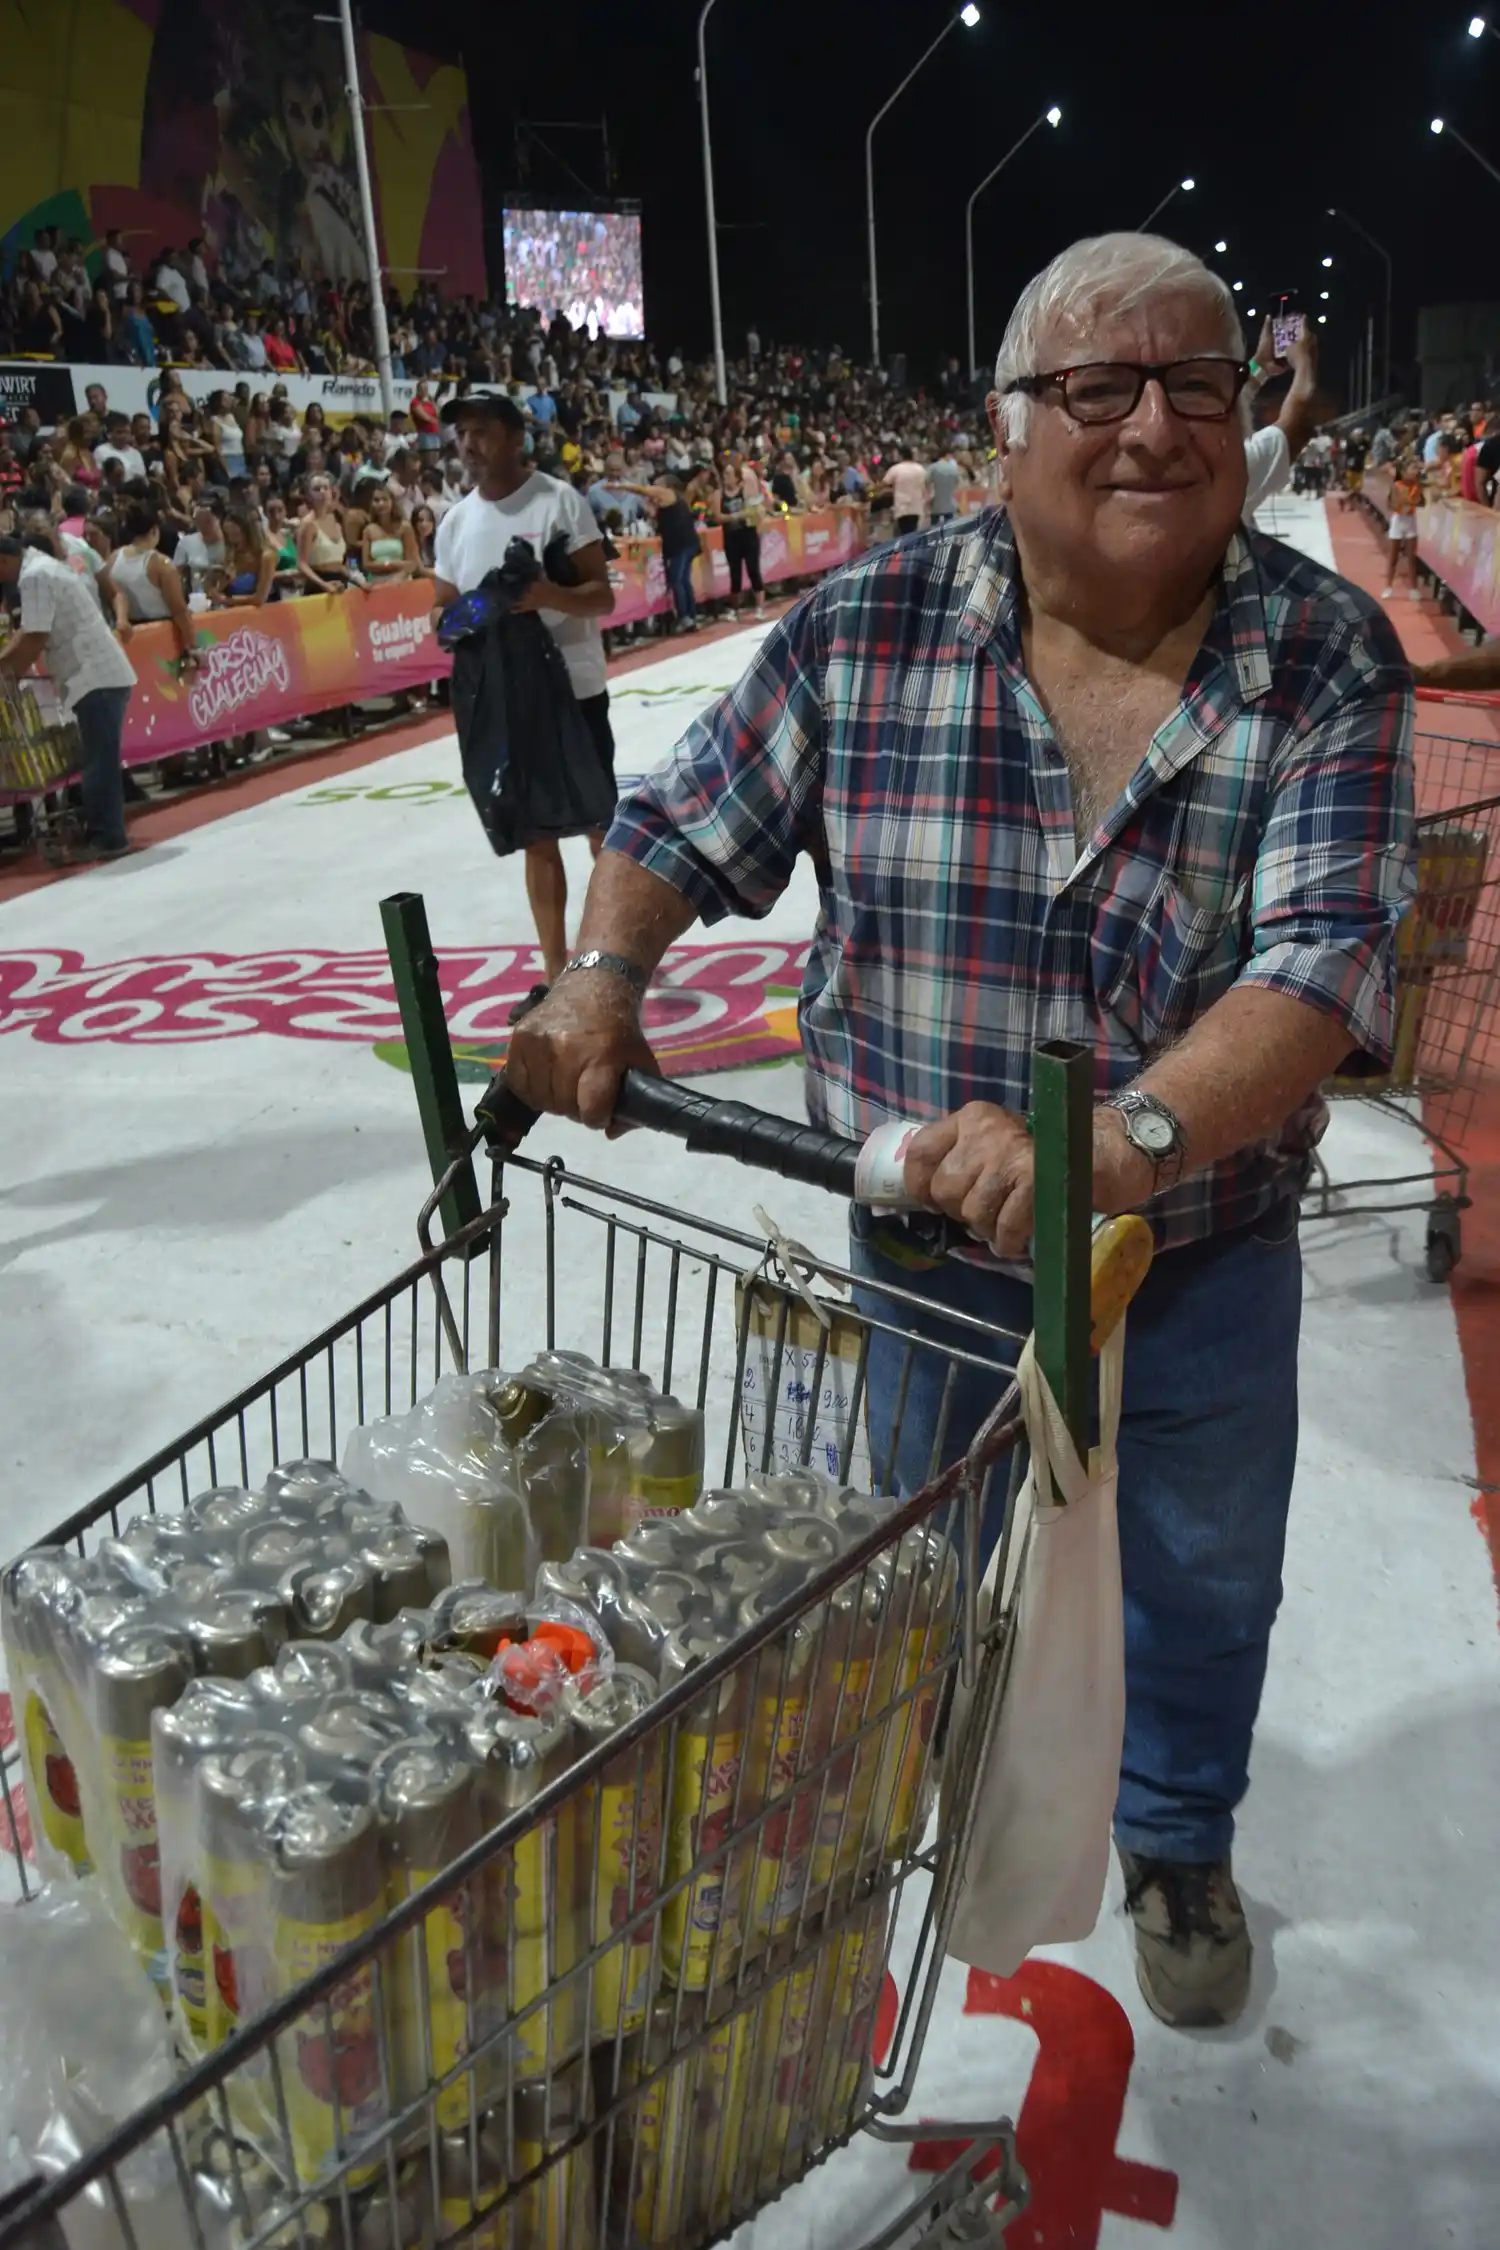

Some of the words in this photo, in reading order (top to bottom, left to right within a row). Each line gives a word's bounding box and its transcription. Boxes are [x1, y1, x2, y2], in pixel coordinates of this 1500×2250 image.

[802, 1353, 829, 1369] 50
[745, 1404, 754, 1423] 4
[749, 1437, 755, 1452] 6
